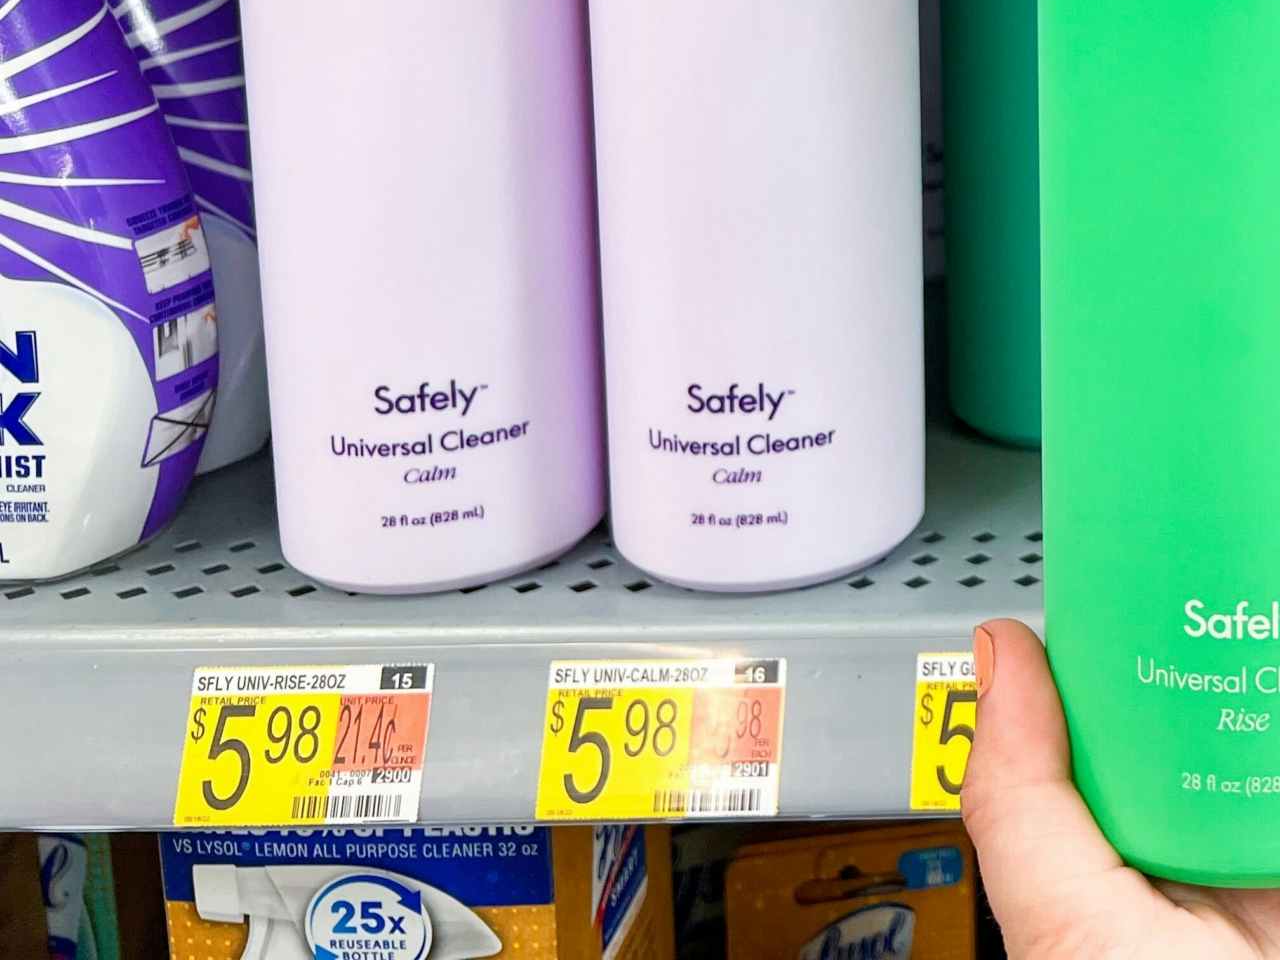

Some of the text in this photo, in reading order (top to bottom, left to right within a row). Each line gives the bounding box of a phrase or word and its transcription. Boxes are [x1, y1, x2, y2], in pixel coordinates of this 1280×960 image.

[330, 419, 531, 458] Universal Cleaner
[648, 427, 837, 457] Universal Cleaner
[403, 465, 457, 484] Calm
[712, 467, 763, 485] Calm
[6, 483, 46, 494] CLEANER
[381, 515, 396, 528] 28
[399, 514, 409, 527] fl
[411, 517, 427, 526] oz
[429, 509, 460, 527] (828
[691, 513, 705, 526] 28
[708, 512, 717, 526] fl
[718, 516, 733, 527] oz
[735, 513, 763, 529] (828
[555, 667, 709, 684] SFLY UNIV-CALM-28OZ
[742, 665, 767, 682] 16
[922, 660, 957, 677] SFLY
[1137, 655, 1248, 694] Universal
[197, 674, 346, 691] SFLY UNIV-RISE-28OZ
[391, 672, 414, 689] 15
[200, 695, 268, 706] RETAIL PRICE
[1216, 707, 1271, 733] Rise
[376, 767, 413, 784] 2900
[735, 761, 769, 777] 2901
[1181, 772, 1201, 791] 28
[1206, 775, 1217, 792] fl
[1220, 780, 1242, 794] oz
[172, 839, 194, 855] VS
[255, 843, 309, 858] LEMON
[313, 844, 342, 858] ALL
[346, 843, 417, 859] PURPOSE
[422, 842, 494, 859] CLEANER
[498, 841, 517, 857] 32
[521, 846, 539, 857] oz
[330, 900, 407, 934] 25x
[329, 939, 407, 950] REUSEABLE
[342, 951, 396, 960] BOTTLE
